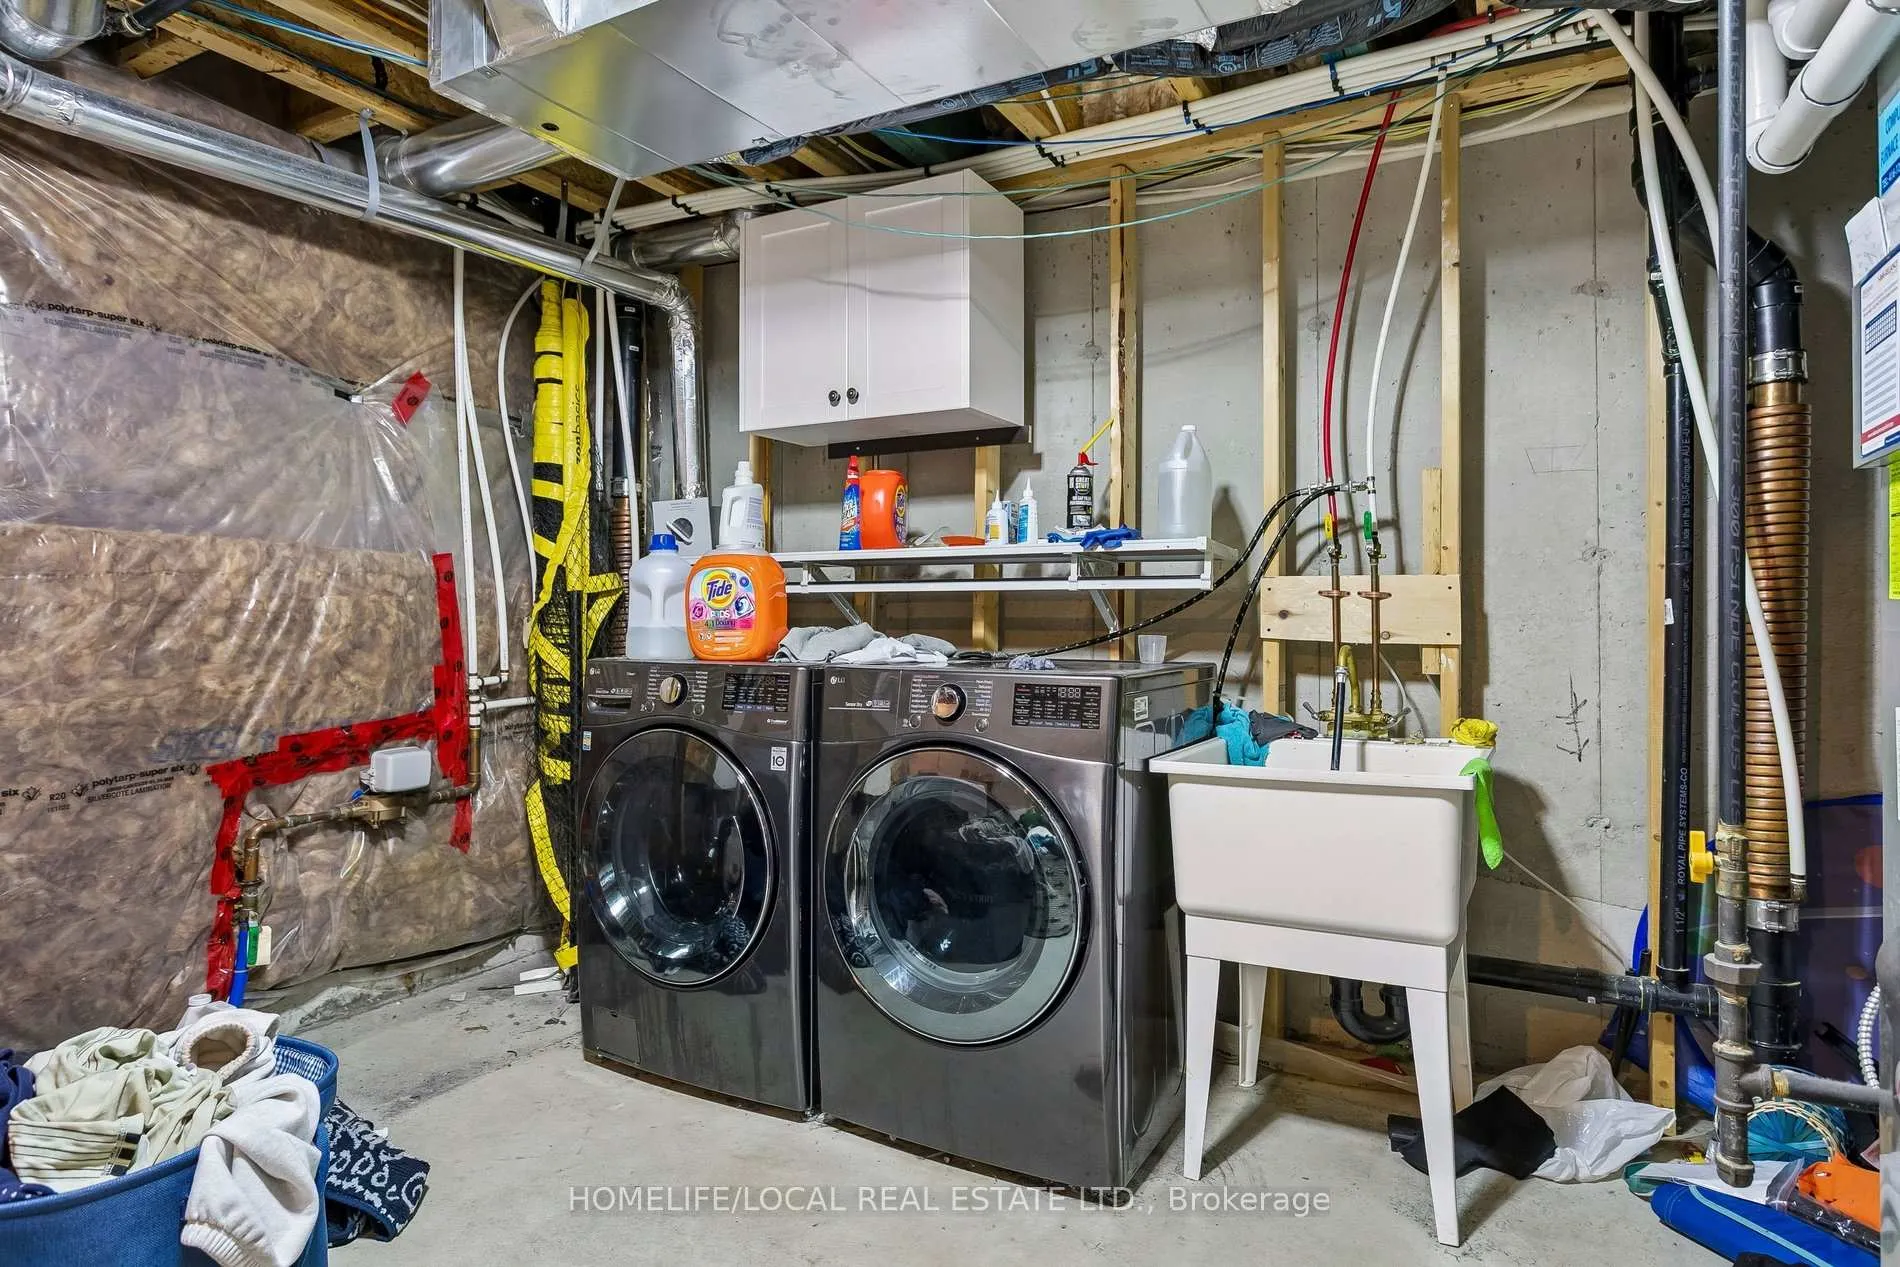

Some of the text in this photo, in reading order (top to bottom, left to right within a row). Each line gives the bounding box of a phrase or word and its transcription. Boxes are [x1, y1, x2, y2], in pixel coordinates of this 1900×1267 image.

[1729, 153, 1742, 232] STEEL
[48, 302, 128, 323] polytarp-super
[130, 316, 145, 327] six
[1730, 412, 1742, 476] PIPE
[1729, 544, 1742, 592] PSI
[706, 579, 733, 602] Tide
[92, 766, 168, 789] polytarp-super
[171, 763, 185, 773] six
[1, 788, 19, 798] six
[49, 791, 67, 801] R20
[1679, 767, 1688, 829] SYSTEMS-CO
[1678, 830, 1687, 851] PIPE
[1677, 854, 1686, 885] ROYAL
